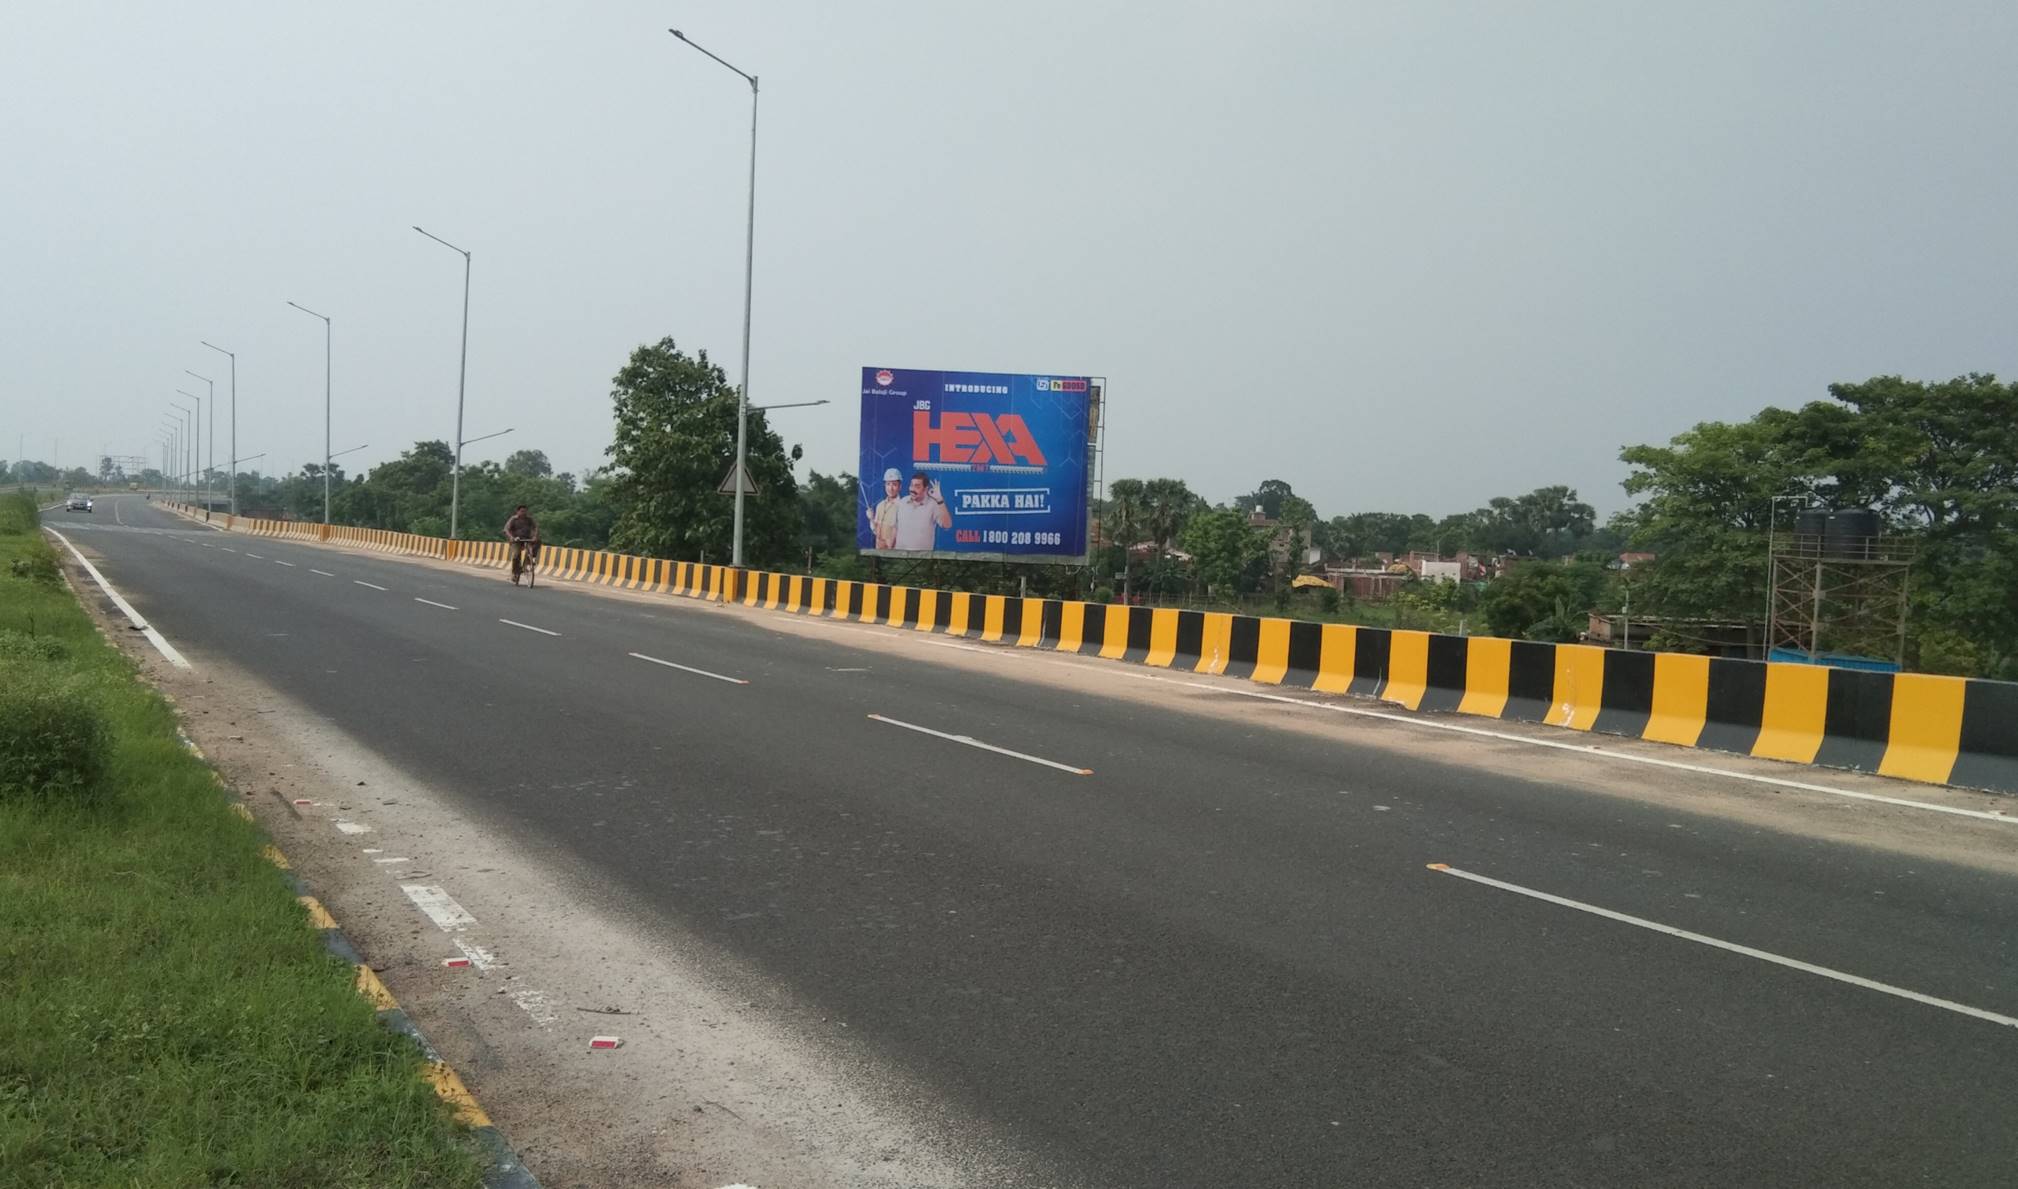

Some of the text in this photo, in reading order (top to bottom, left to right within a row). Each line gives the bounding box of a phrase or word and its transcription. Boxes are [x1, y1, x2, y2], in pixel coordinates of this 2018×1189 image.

[944, 384, 1008, 394] INTRODUCING
[913, 400, 931, 409] JBG
[912, 410, 1047, 464] HEXA
[962, 494, 1045, 508] PAKKA HAI!
[956, 529, 980, 543] CALL
[1011, 531, 1032, 545] 208
[1034, 532, 1061, 546] 9966
